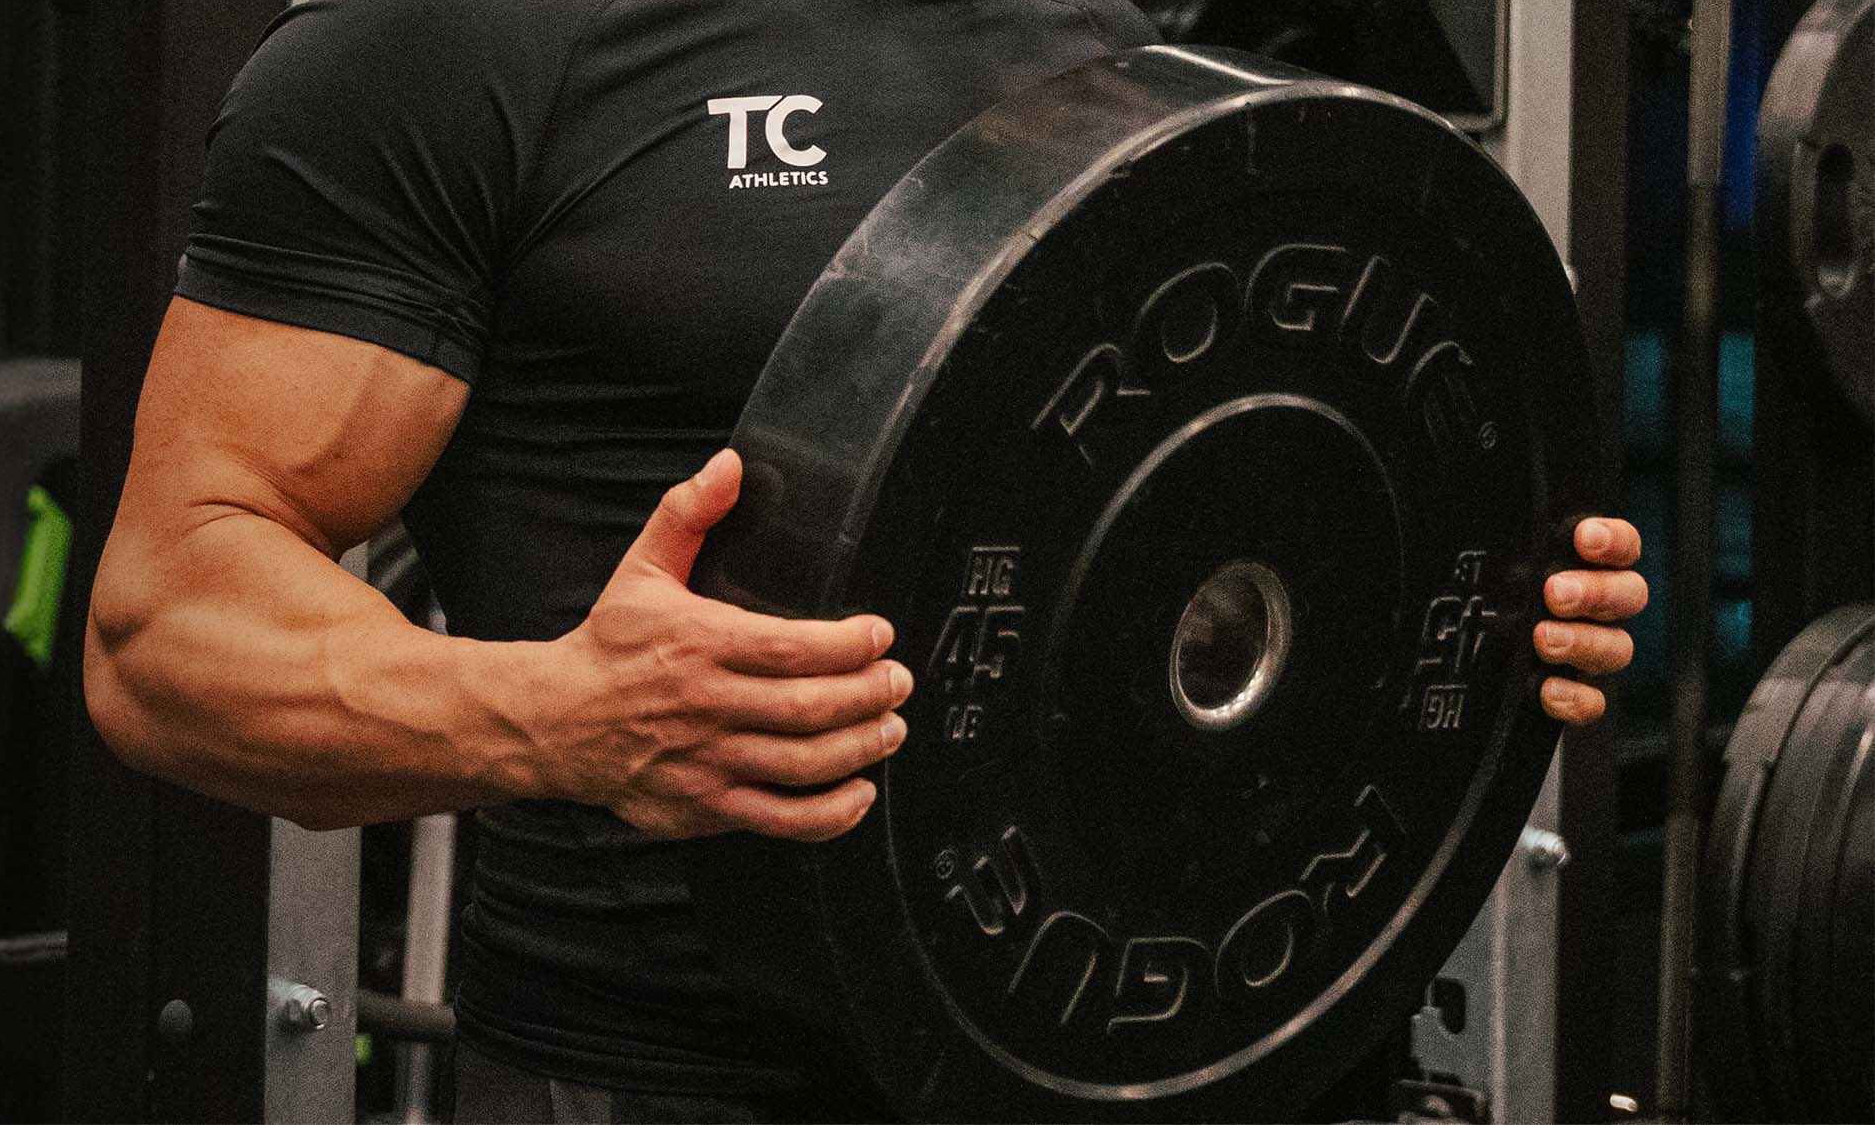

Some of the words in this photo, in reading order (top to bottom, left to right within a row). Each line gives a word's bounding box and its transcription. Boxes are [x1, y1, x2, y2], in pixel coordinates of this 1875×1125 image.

[707, 94, 828, 169] TC
[729, 171, 828, 189] ATHLETICS
[926, 605, 1025, 693] 45
[1414, 594, 1499, 675] 45
